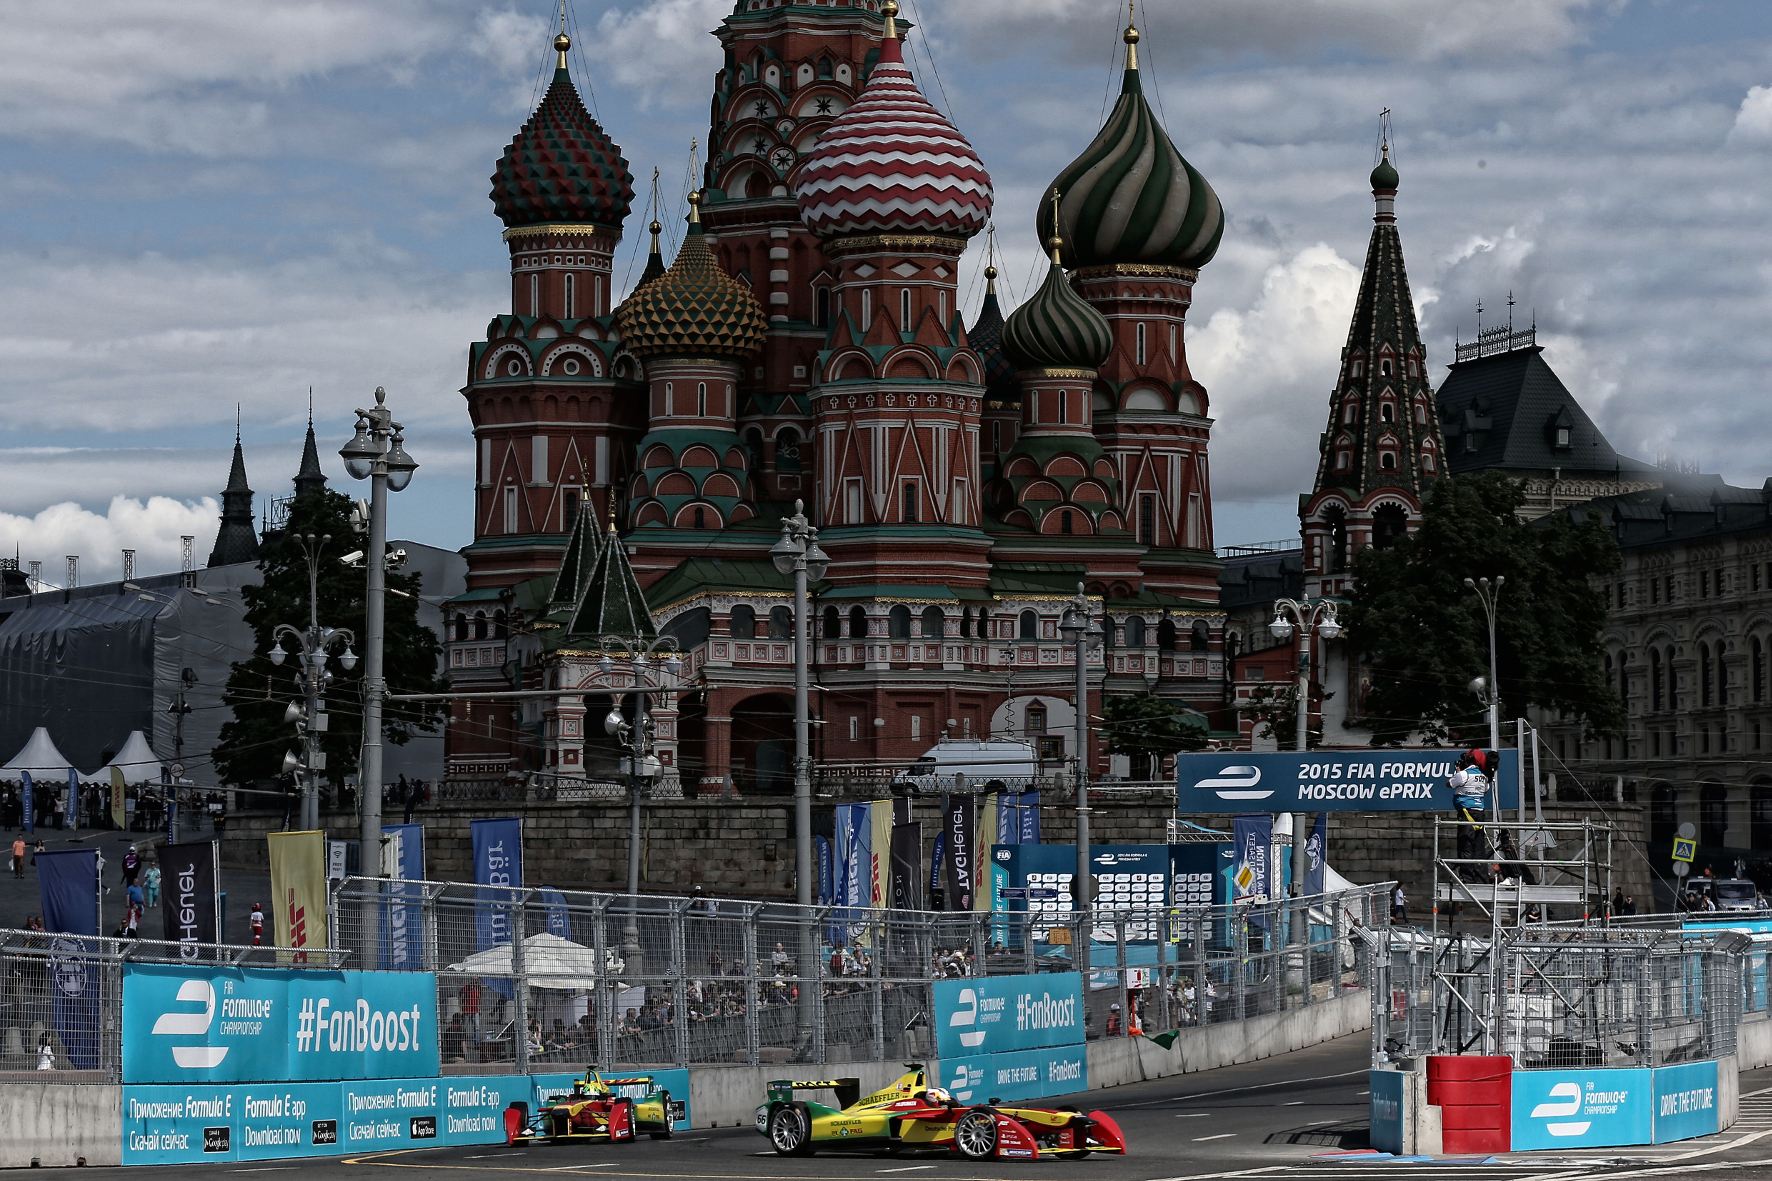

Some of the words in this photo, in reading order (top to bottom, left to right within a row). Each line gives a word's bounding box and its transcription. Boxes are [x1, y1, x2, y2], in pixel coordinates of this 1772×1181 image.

[1298, 763, 1343, 779] 2015
[1347, 763, 1375, 779] FIA
[1380, 763, 1454, 779] FORMUL
[1298, 784, 1376, 800] MOSCOW
[1379, 783, 1434, 799] ePRIX
[998, 851, 1010, 859] FIA
[224, 981, 234, 995] FIA
[980, 1013, 1001, 1024] CHAMPIONSHIP
[1017, 992, 1075, 1031] #FanBoost
[220, 1021, 262, 1035] CHAMPIONSHIP
[297, 998, 420, 1052] #FanBoost
[997, 1070, 1011, 1085] DRIVE
[1011, 1069, 1020, 1083] THE
[1021, 1067, 1037, 1081] FUTURE
[1049, 1060, 1080, 1082] #FanBoost
[1586, 1082, 1594, 1091] FIA
[245, 1094, 282, 1118] Formula
[285, 1095, 291, 1116] E
[292, 1100, 306, 1120] app
[349, 1093, 395, 1115] Приложение
[397, 1087, 429, 1108] Formula
[431, 1086, 437, 1107] E
[448, 1086, 479, 1108] Formula
[481, 1086, 487, 1106] E
[488, 1090, 500, 1110] app
[859, 1092, 900, 1106] SCHAEFFLER
[1661, 1094, 1678, 1117] DRIVE
[1679, 1092, 1690, 1113] THE
[1690, 1087, 1713, 1111] FUTURE
[130, 1098, 183, 1123] Приложение
[185, 1096, 224, 1118] Formula
[225, 1095, 232, 1117] E
[1584, 1105, 1618, 1115] CHAMPIONSHIP
[448, 1114, 481, 1134] Download
[482, 1117, 496, 1131] now
[757, 1114, 766, 1125] 66
[245, 1125, 283, 1147] Download
[285, 1128, 301, 1144] now
[350, 1120, 375, 1140] Скачай
[377, 1119, 401, 1138] сейчас
[418, 1126, 426, 1137] App
[130, 1130, 159, 1151] Скачай
[161, 1129, 189, 1150] сейчас
